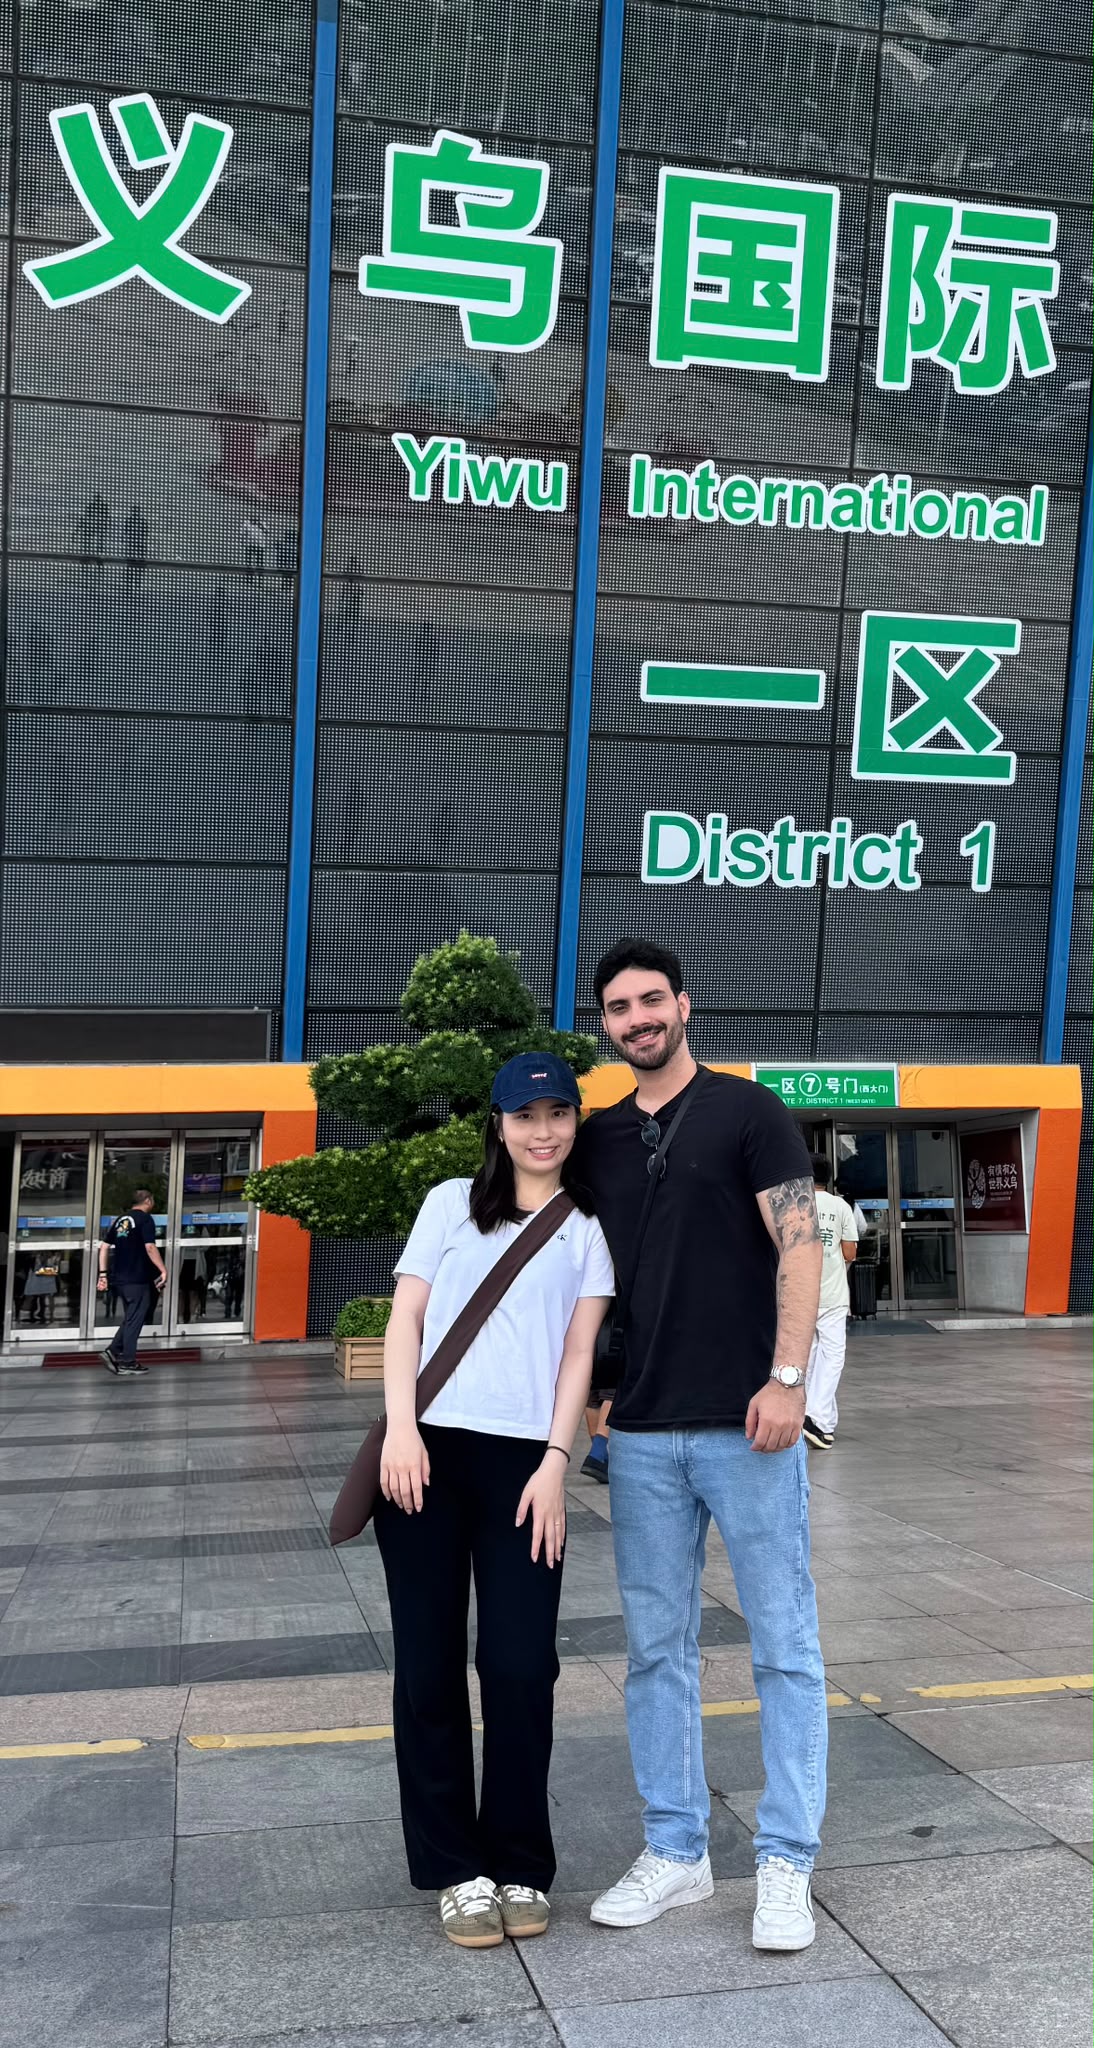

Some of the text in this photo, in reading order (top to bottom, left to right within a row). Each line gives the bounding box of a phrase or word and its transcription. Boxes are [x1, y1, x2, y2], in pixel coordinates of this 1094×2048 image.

[23, 93, 1060, 396] 义乌国际
[392, 432, 1050, 546] Yiwu International
[641, 611, 1022, 785] 一区
[641, 811, 996, 892] District 1
[806, 1097, 838, 1105] DISTRICT
[988, 1176, 1018, 1190] 世界义乌
